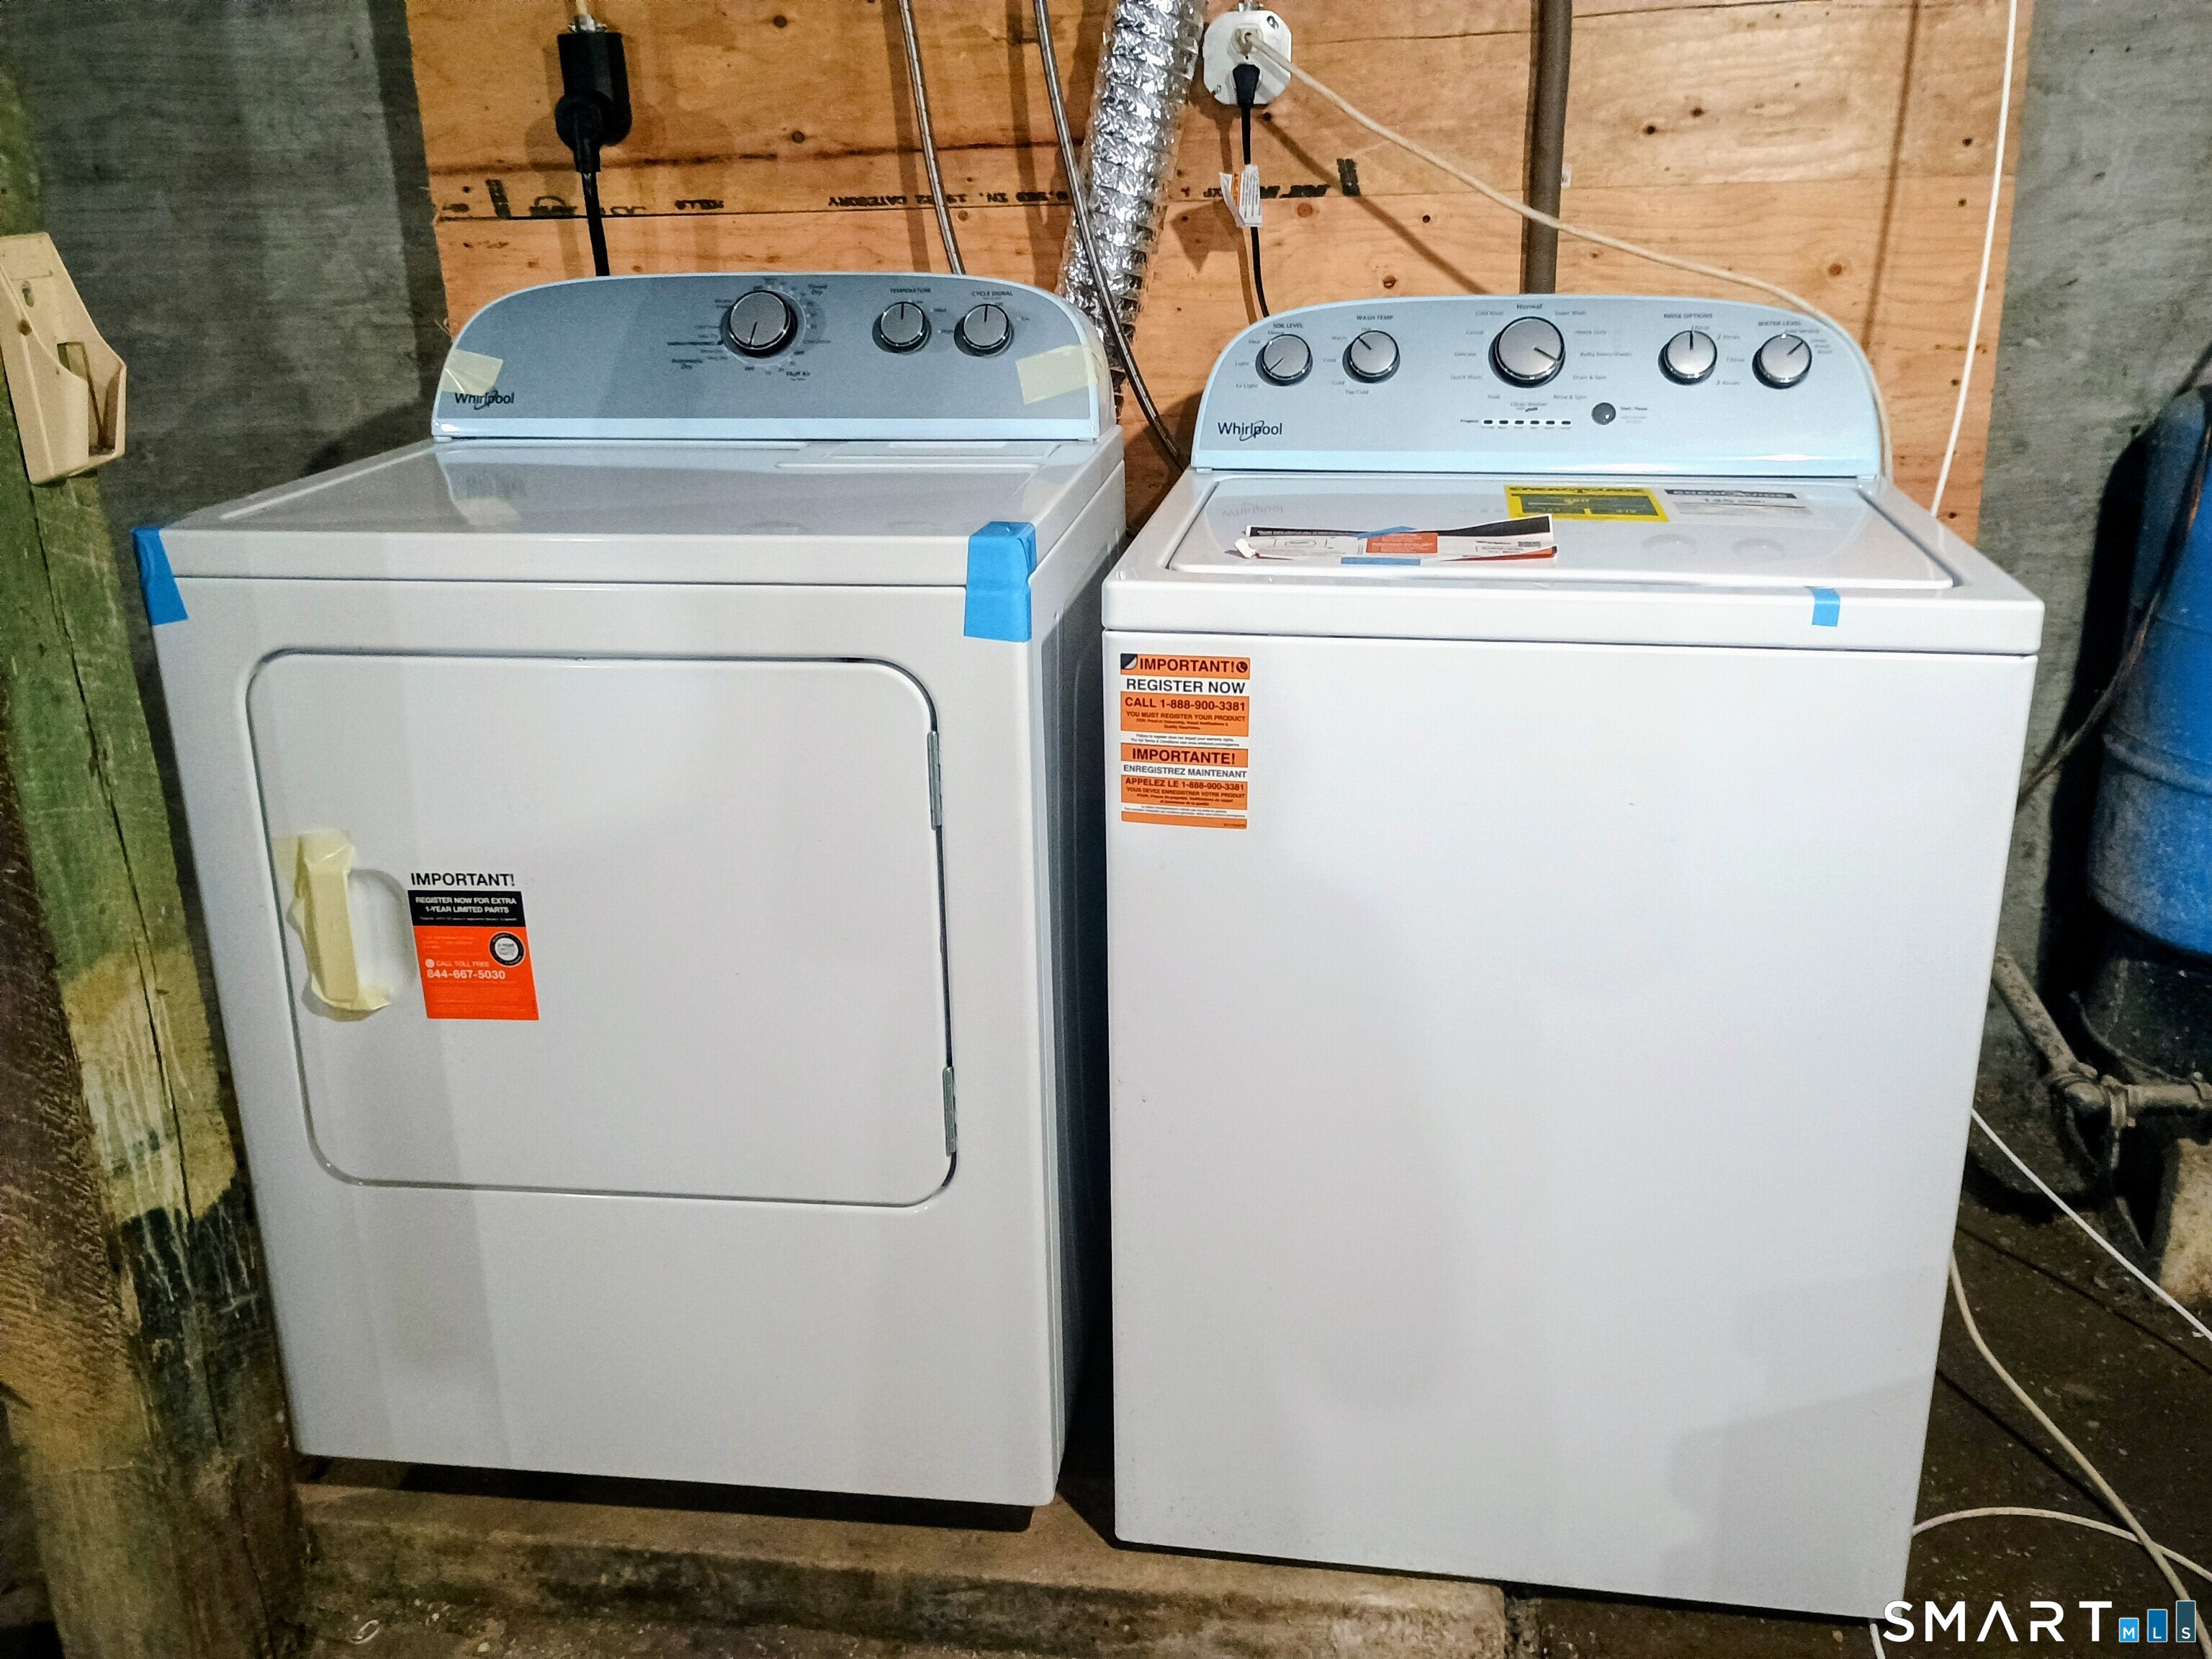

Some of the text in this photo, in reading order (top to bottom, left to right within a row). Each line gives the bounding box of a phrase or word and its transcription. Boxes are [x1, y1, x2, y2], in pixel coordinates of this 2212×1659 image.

[1218, 420, 1282, 441] Whirlpool
[1140, 657, 1235, 673] IMPORTANT!
[1126, 678, 1246, 693] REGISTER NOW
[1125, 696, 1245, 711] CALL 1-888-900-3381
[1132, 747, 1235, 765] IMPORTANTE!
[1123, 765, 1247, 778] ENREGISTREZ MAINTENANT
[1125, 777, 1244, 791] APPELEZ LE 1-888-900-3381
[410, 872, 516, 886] IMPORTANT!
[427, 968, 505, 980] 844-667-5030
